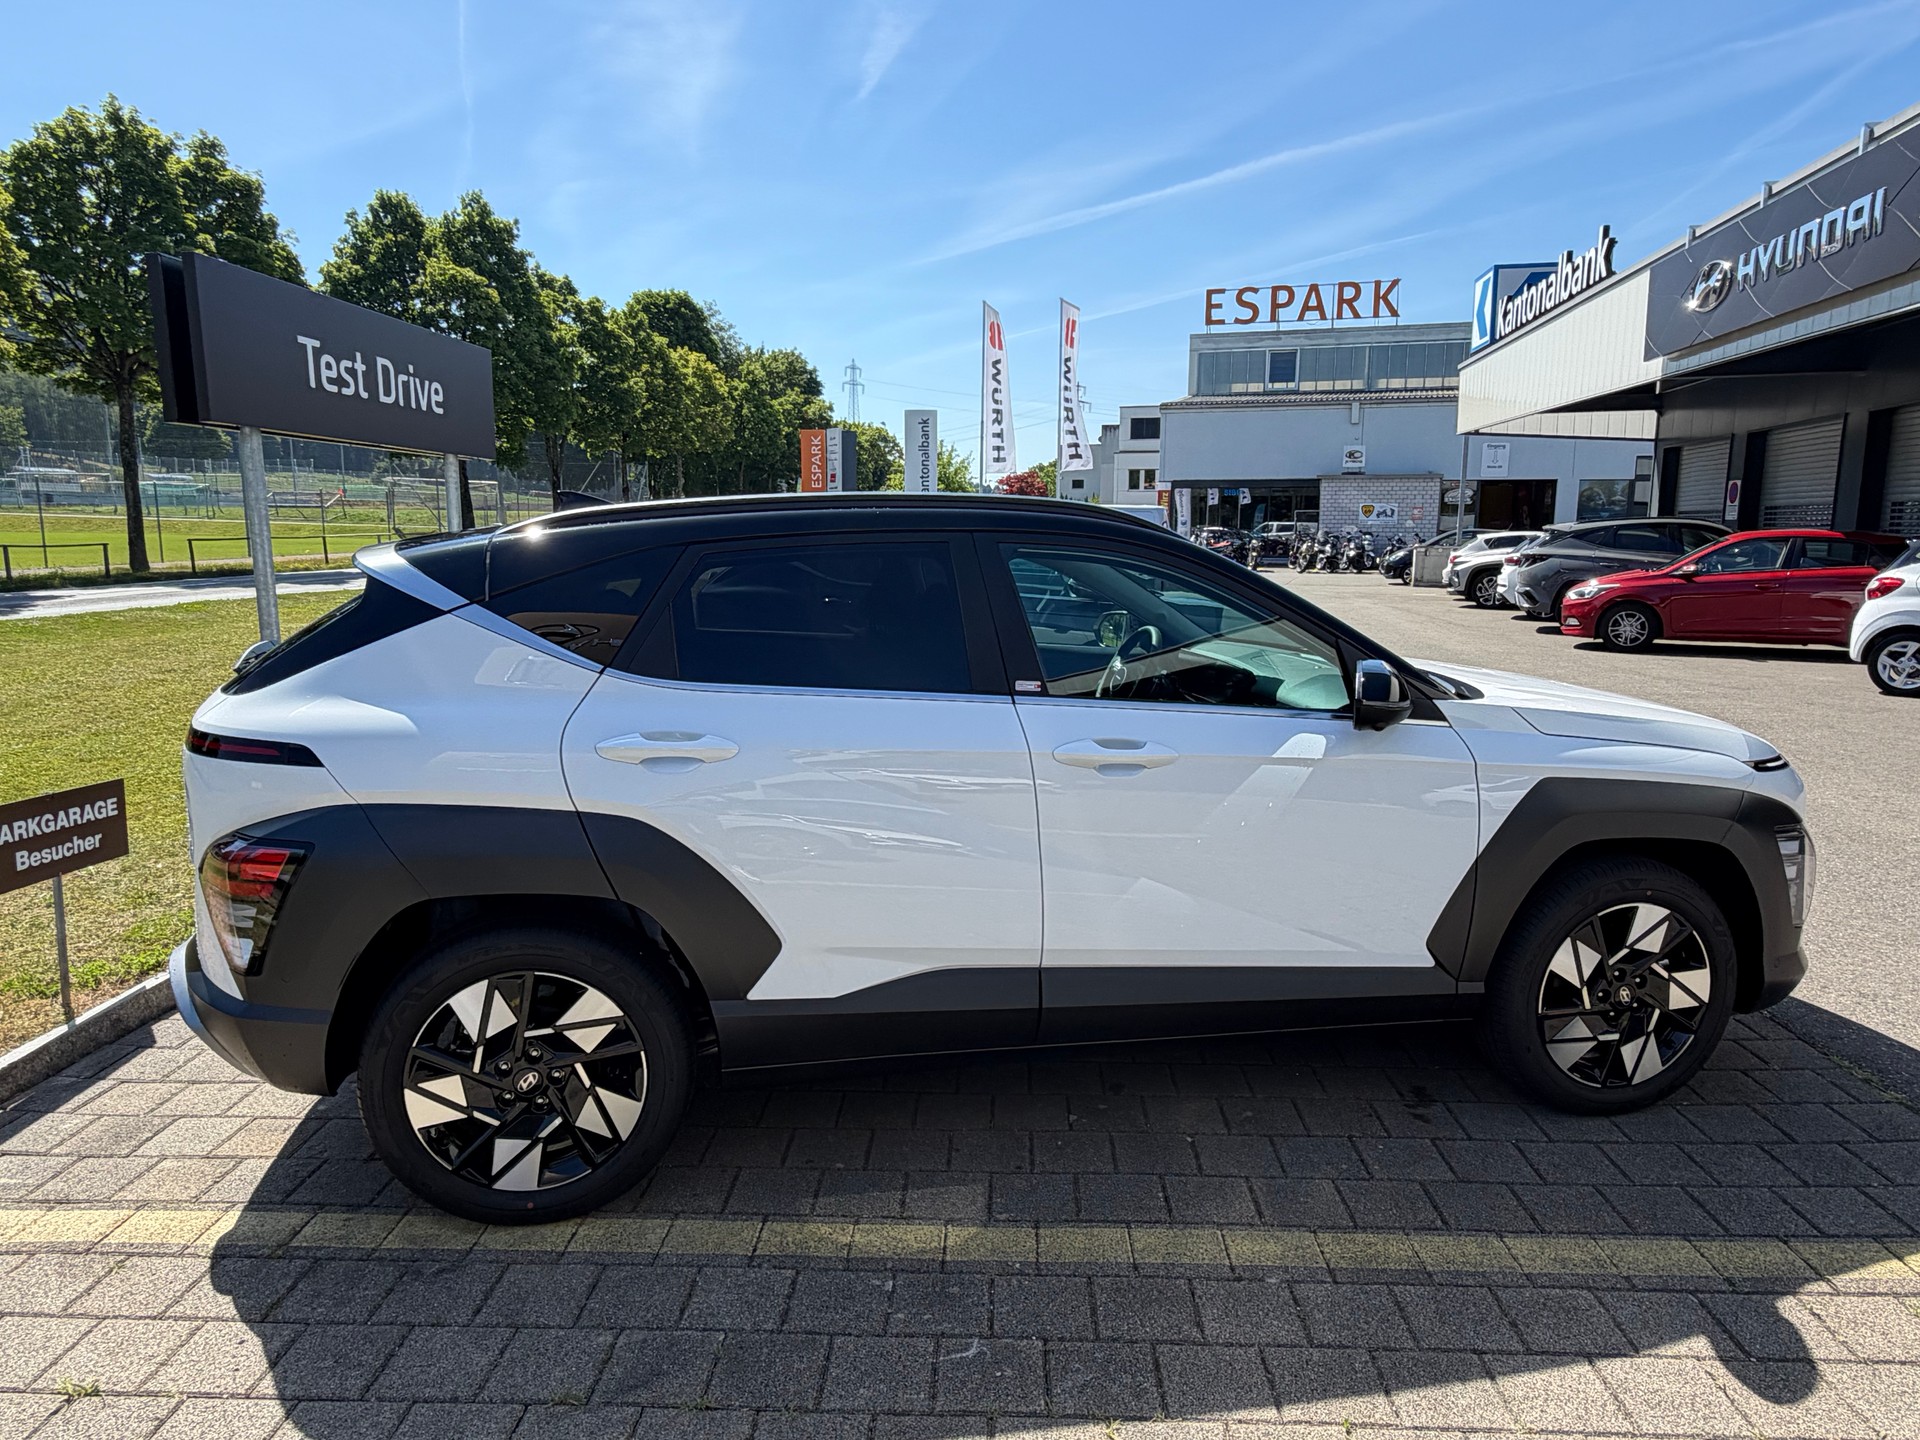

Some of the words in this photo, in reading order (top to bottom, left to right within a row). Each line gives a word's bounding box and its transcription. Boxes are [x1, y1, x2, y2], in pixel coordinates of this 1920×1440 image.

[1736, 186, 1888, 291] HYUNDAI
[1205, 278, 1402, 326] ESPARK
[1495, 226, 1616, 340] Kantonalbank
[296, 335, 369, 399] Test
[376, 356, 445, 415] Drive
[991, 358, 1007, 464] WÜRTH
[811, 435, 822, 488] ESPARK
[917, 417, 930, 493] antonalbank
[0, 797, 119, 846] ARKGARAGE
[15, 833, 102, 872] Besucher
